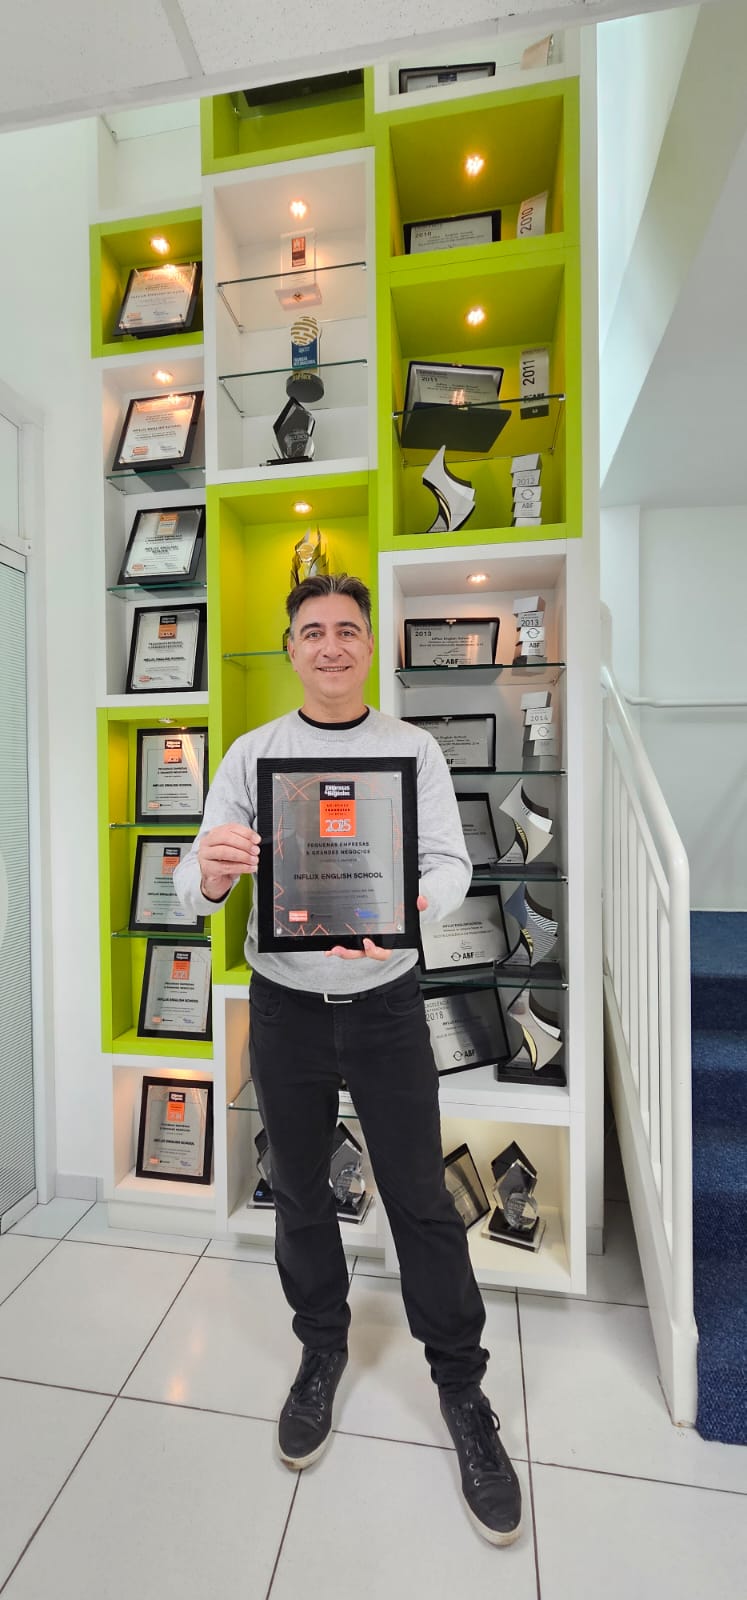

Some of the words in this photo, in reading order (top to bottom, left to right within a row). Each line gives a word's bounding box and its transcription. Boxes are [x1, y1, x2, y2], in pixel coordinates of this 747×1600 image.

[519, 207, 534, 234] 2010
[522, 359, 535, 386] 2011
[517, 477, 535, 486] 2012
[521, 619, 539, 627] 2013
[325, 819, 352, 832] 2025
[321, 872, 353, 880] ENGLISH
[353, 871, 384, 879] SCHOOL
[425, 1010, 443, 1022] 2018
[464, 1049, 475, 1058] ABF
